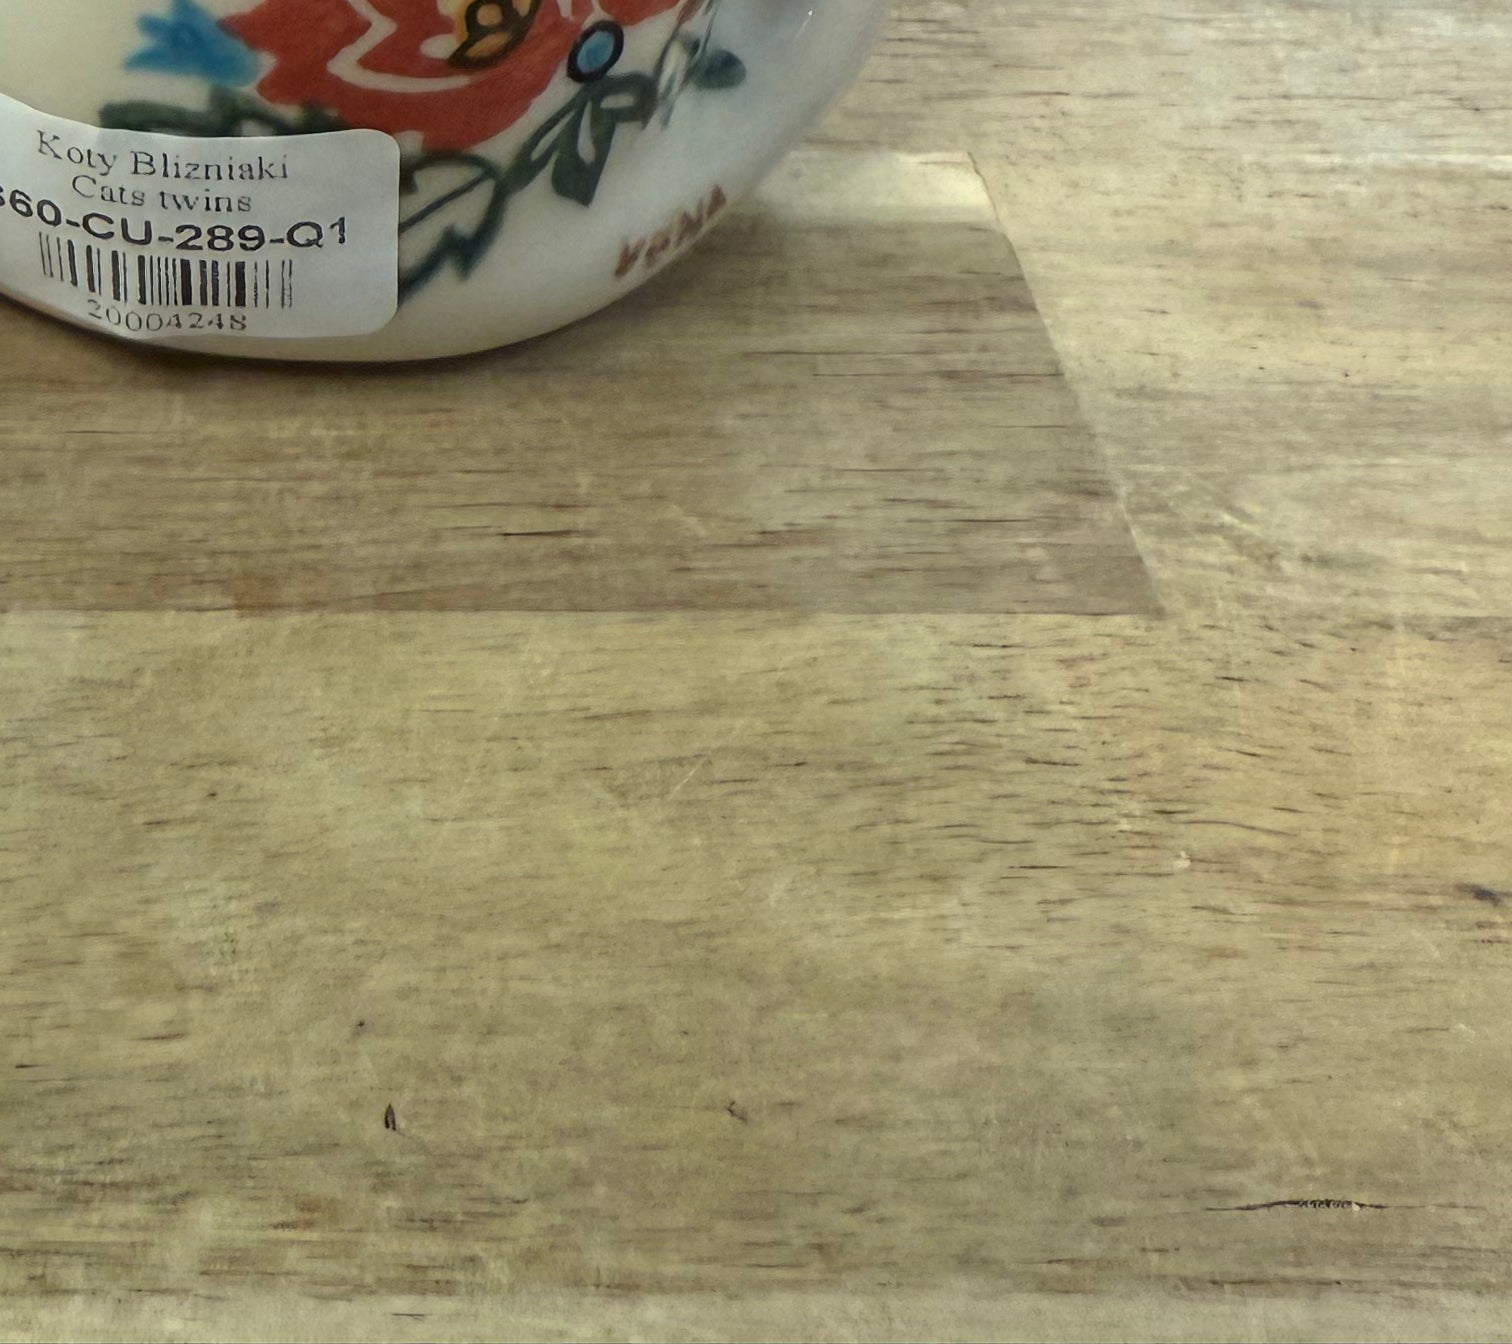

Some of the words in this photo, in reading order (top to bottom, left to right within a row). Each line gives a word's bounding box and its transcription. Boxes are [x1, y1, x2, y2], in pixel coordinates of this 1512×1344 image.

[37, 130, 118, 176] Koty
[130, 151, 289, 180] Blizniaki
[72, 175, 145, 206] Cats
[159, 189, 252, 212] twins
[88, 299, 248, 332] 20004248
